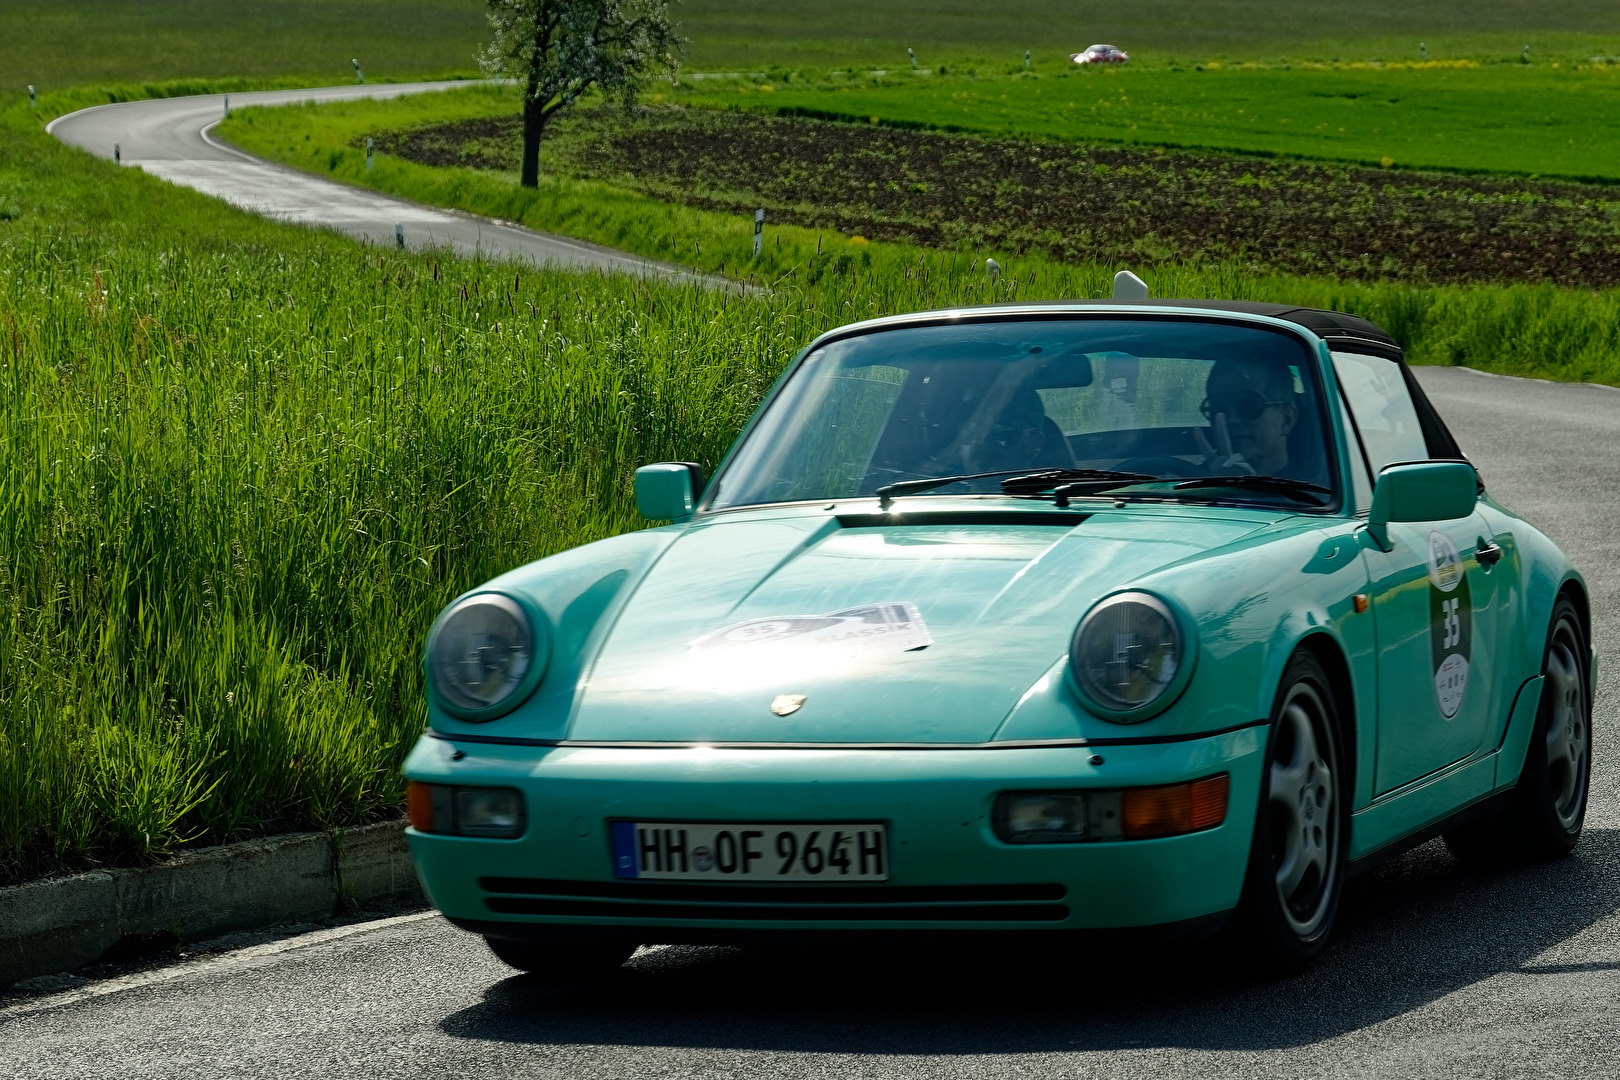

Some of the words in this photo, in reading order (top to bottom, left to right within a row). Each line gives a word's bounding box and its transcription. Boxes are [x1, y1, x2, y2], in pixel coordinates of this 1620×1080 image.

[742, 624, 775, 637] 35
[815, 622, 912, 644] KLASSIK
[1442, 597, 1460, 649] 35
[639, 829, 688, 872] HH
[715, 830, 763, 874] OF
[775, 830, 883, 875] 964H
